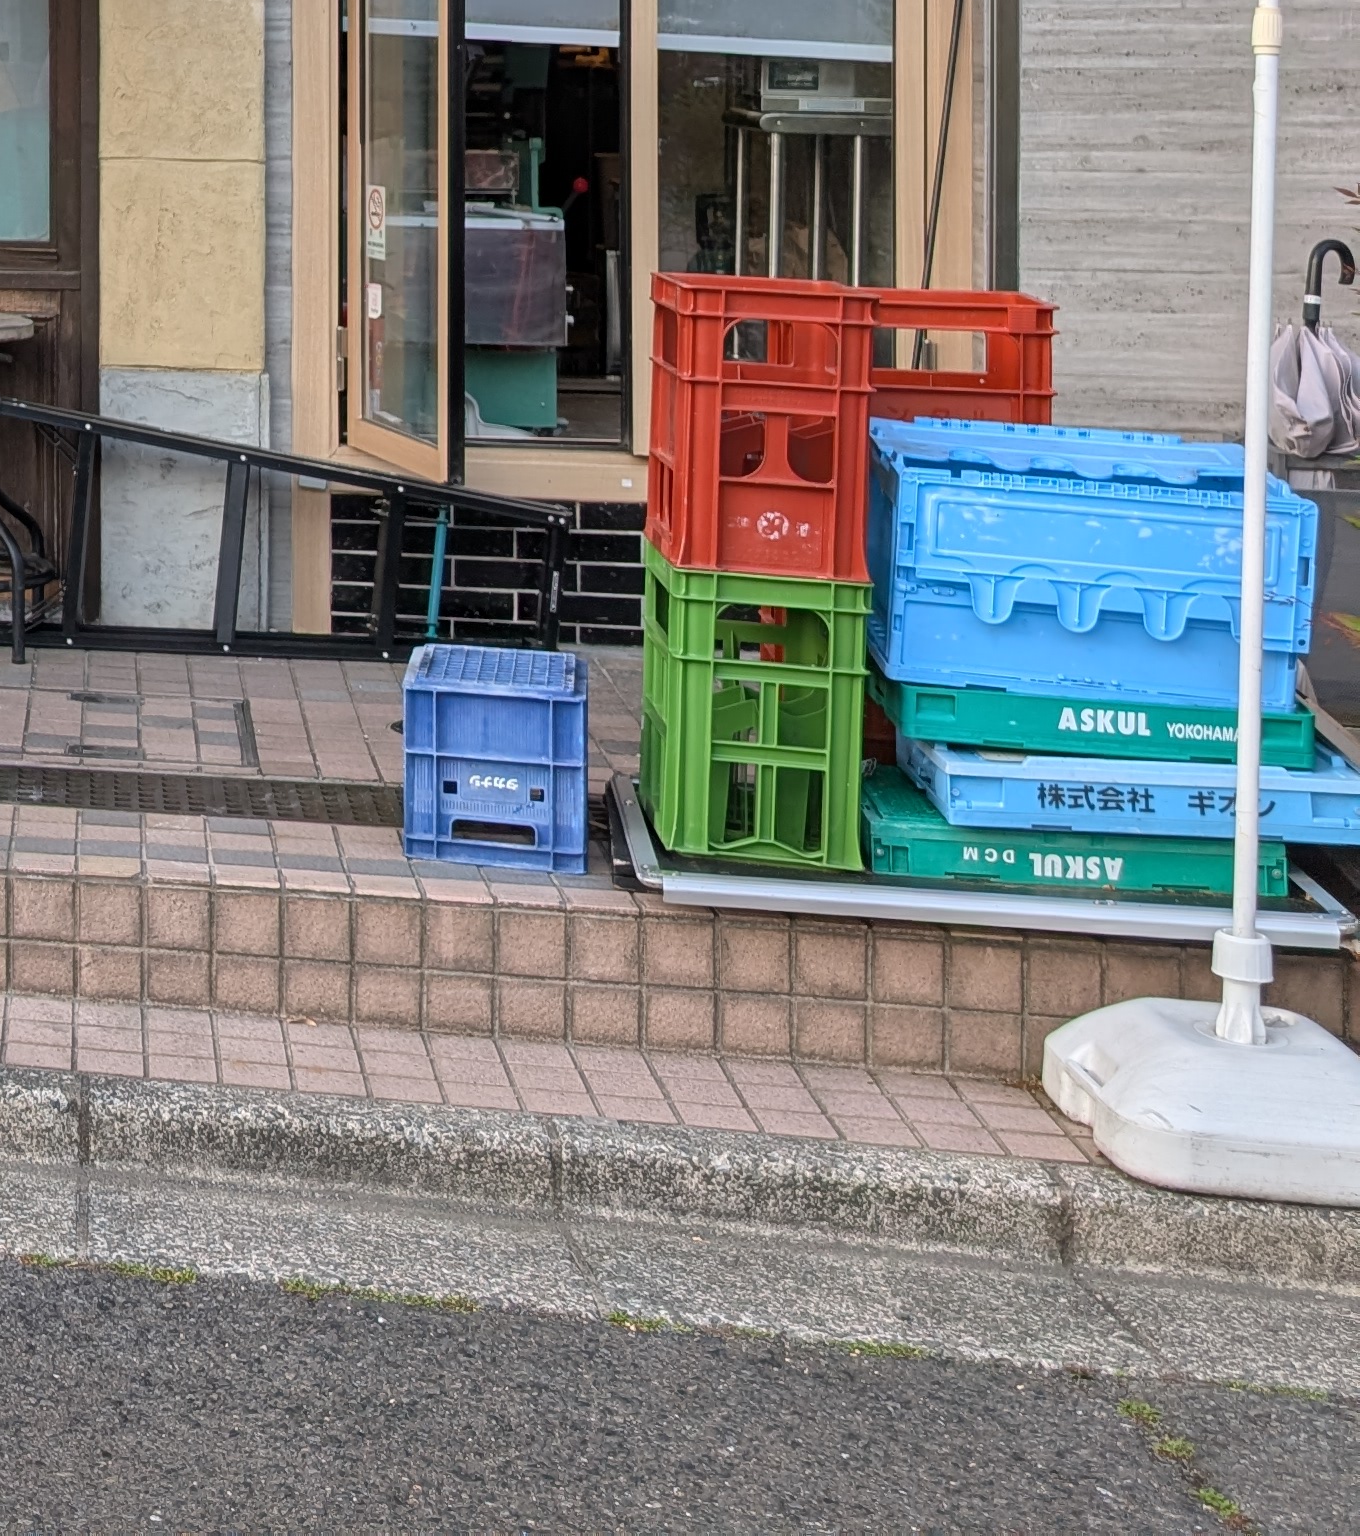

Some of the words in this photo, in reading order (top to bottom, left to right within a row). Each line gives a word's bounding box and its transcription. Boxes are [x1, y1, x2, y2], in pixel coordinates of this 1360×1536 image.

[1057, 707, 1152, 737] ASKUL
[469, 774, 519, 791] タカナシ
[1037, 782, 1155, 813] 株式会社
[962, 846, 1016, 865] DCM
[1028, 852, 1123, 881] ASKUL
